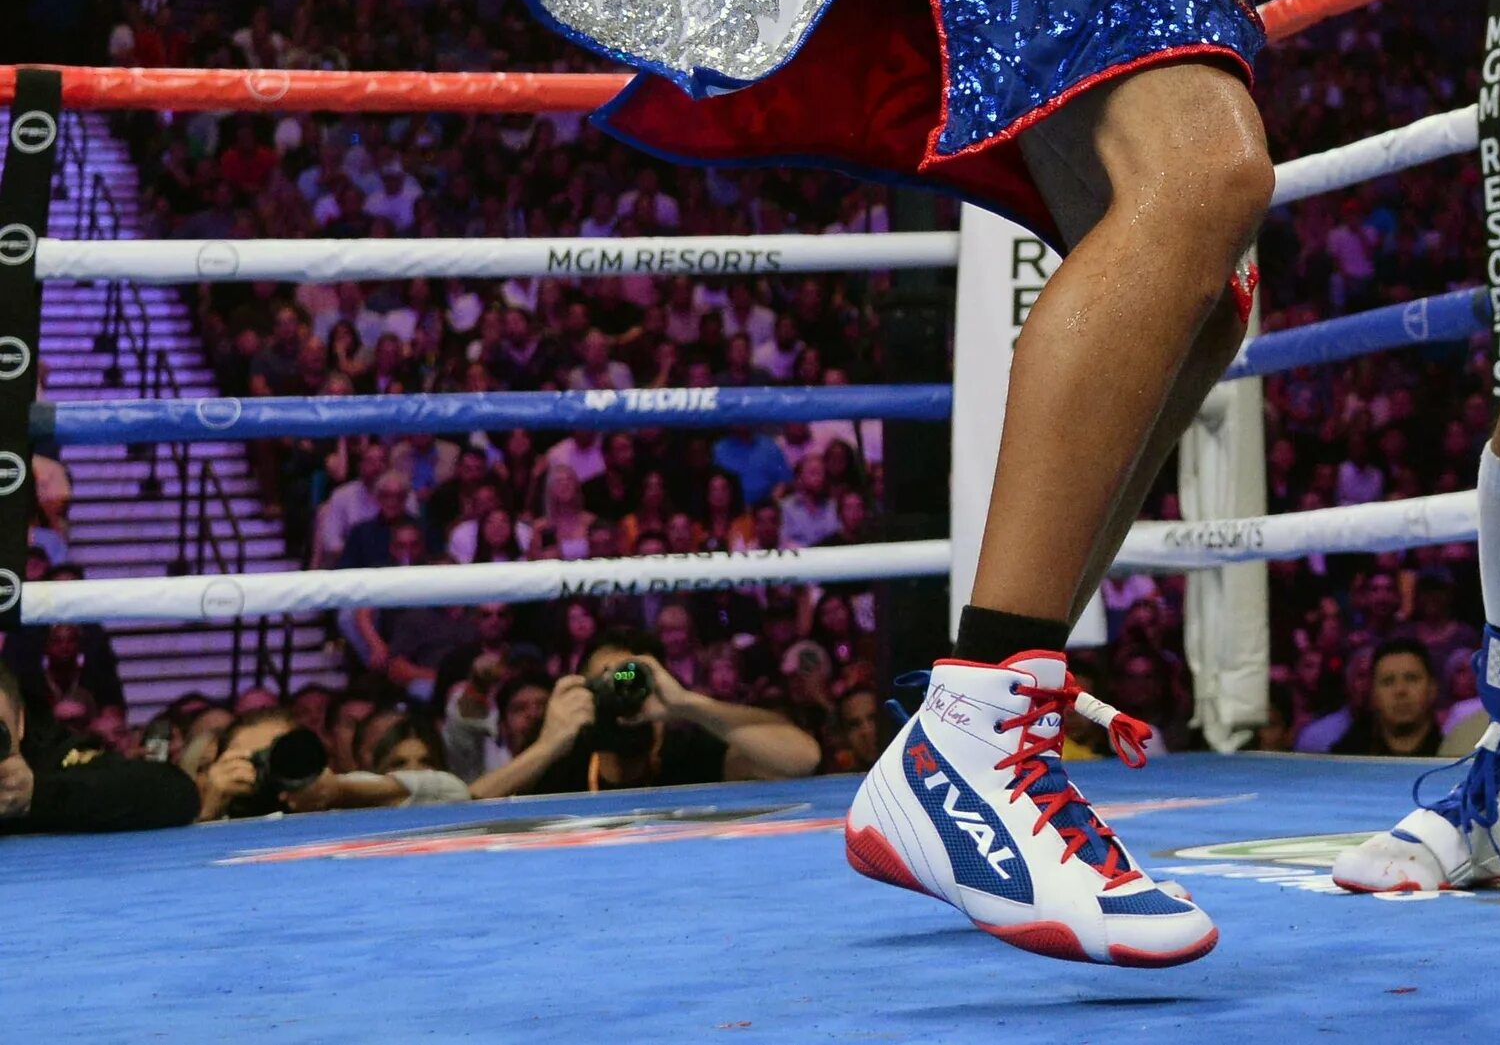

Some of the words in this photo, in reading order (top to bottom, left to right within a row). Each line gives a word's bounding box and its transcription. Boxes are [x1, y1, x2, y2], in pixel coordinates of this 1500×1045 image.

[547, 248, 624, 273] MGM
[634, 249, 782, 272] RESORTS
[624, 387, 720, 411] TECATE
[908, 744, 1011, 881] RIVAL
